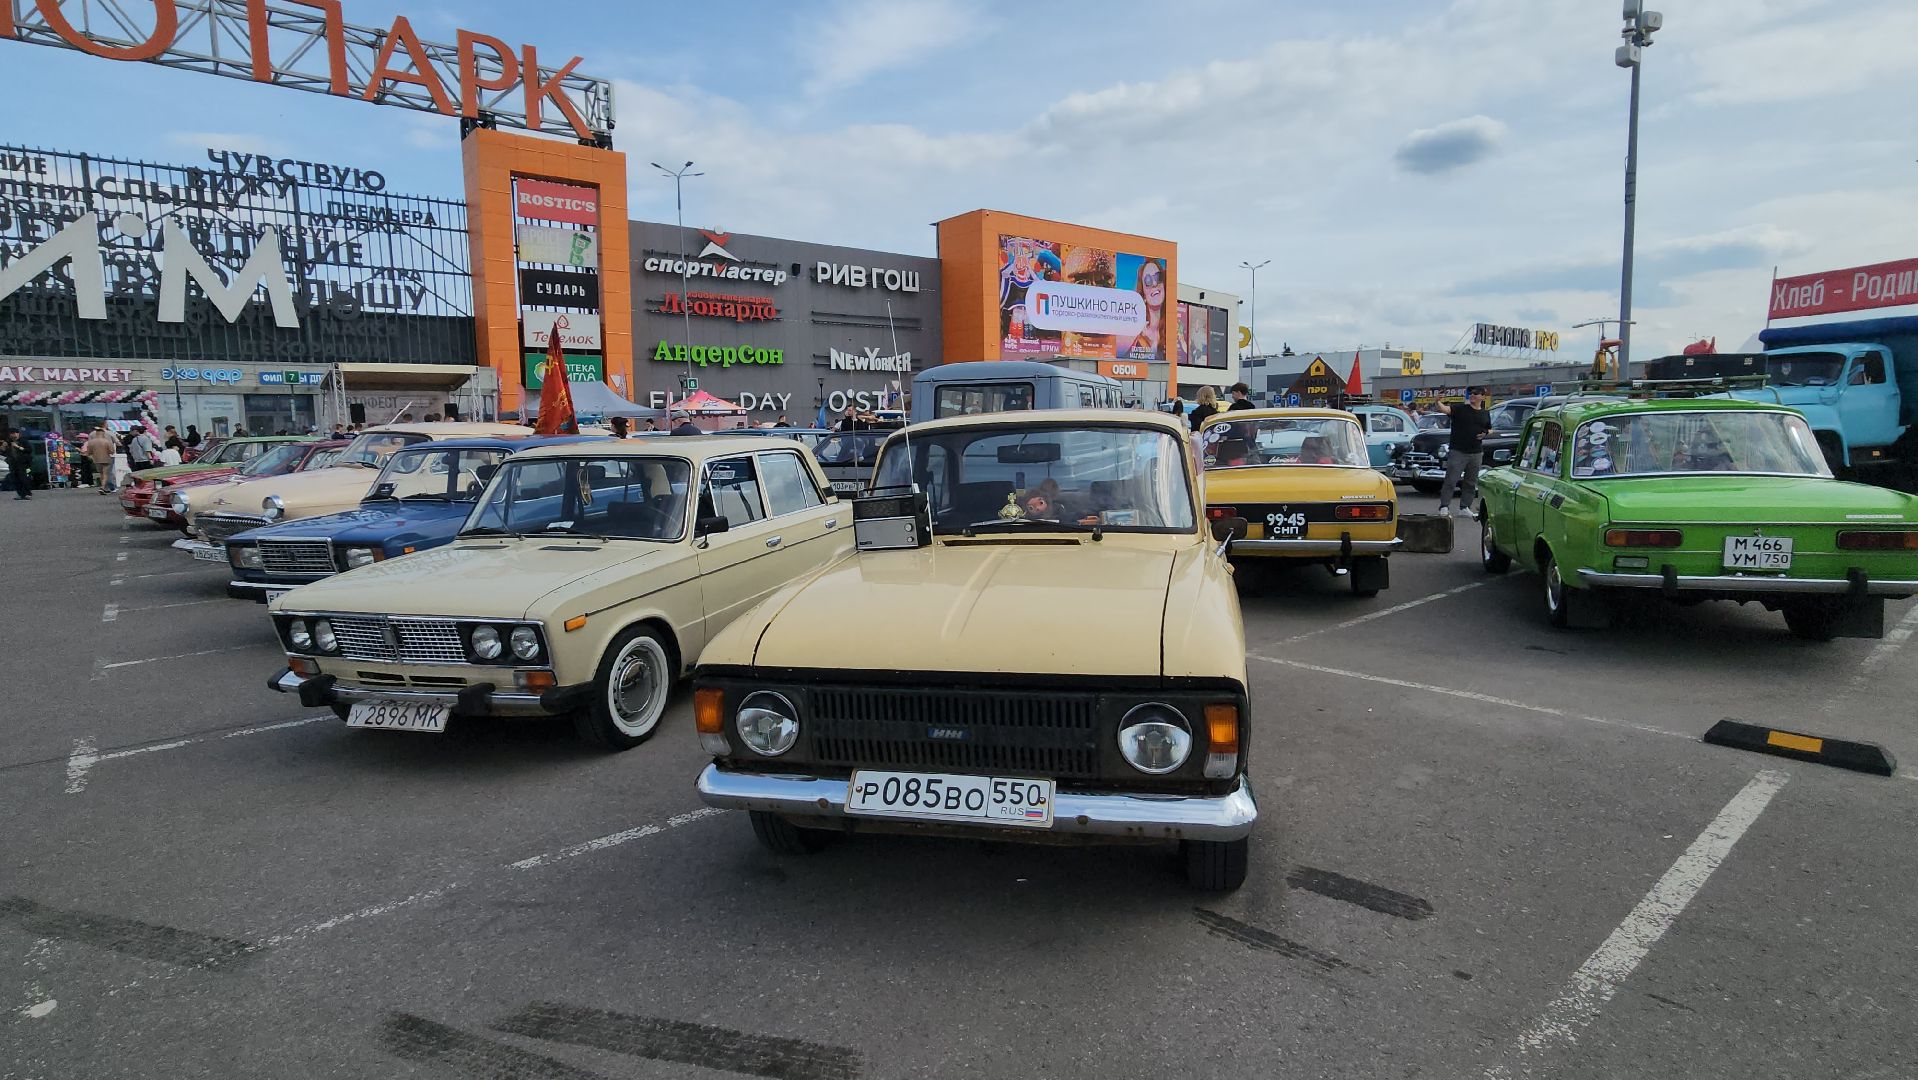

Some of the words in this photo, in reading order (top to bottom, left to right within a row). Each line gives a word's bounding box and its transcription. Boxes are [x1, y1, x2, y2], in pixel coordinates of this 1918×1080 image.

[247, 0, 595, 140] ПАРК
[208, 148, 386, 192] ЧУВСТВУЮ
[187, 166, 294, 199] ВИЖУ
[96, 176, 240, 212] СЛЫШУ
[519, 192, 596, 213] ROSTIC'S
[327, 201, 437, 227] ПРЕМЬЕРА
[645, 258, 787, 286] спортмастер
[817, 261, 867, 288] РИВ
[872, 267, 920, 293] ГОШ
[536, 282, 586, 296] СУДАРЬ
[1772, 278, 1825, 311] Хлеб
[659, 292, 777, 322] Леонардо
[1051, 295, 1108, 312] ПУШКИНО
[1110, 301, 1138, 315] ПАРК
[532, 331, 593, 345] Теемок
[1535, 330, 1559, 352] ПРО
[43, 367, 132, 382] МАРКЕТ
[1112, 365, 1137, 376] ОБОИ
[740, 392, 791, 411] DAY
[1266, 513, 1306, 526] 99-45
[1273, 526, 1299, 535] СНП
[1752, 538, 1783, 551] 466
[1732, 553, 1757, 566] УМ
[1764, 553, 1789, 564] 750
[861, 777, 985, 811] Р085ВО
[992, 781, 1041, 806] 550
[1000, 806, 1025, 816] RUS
